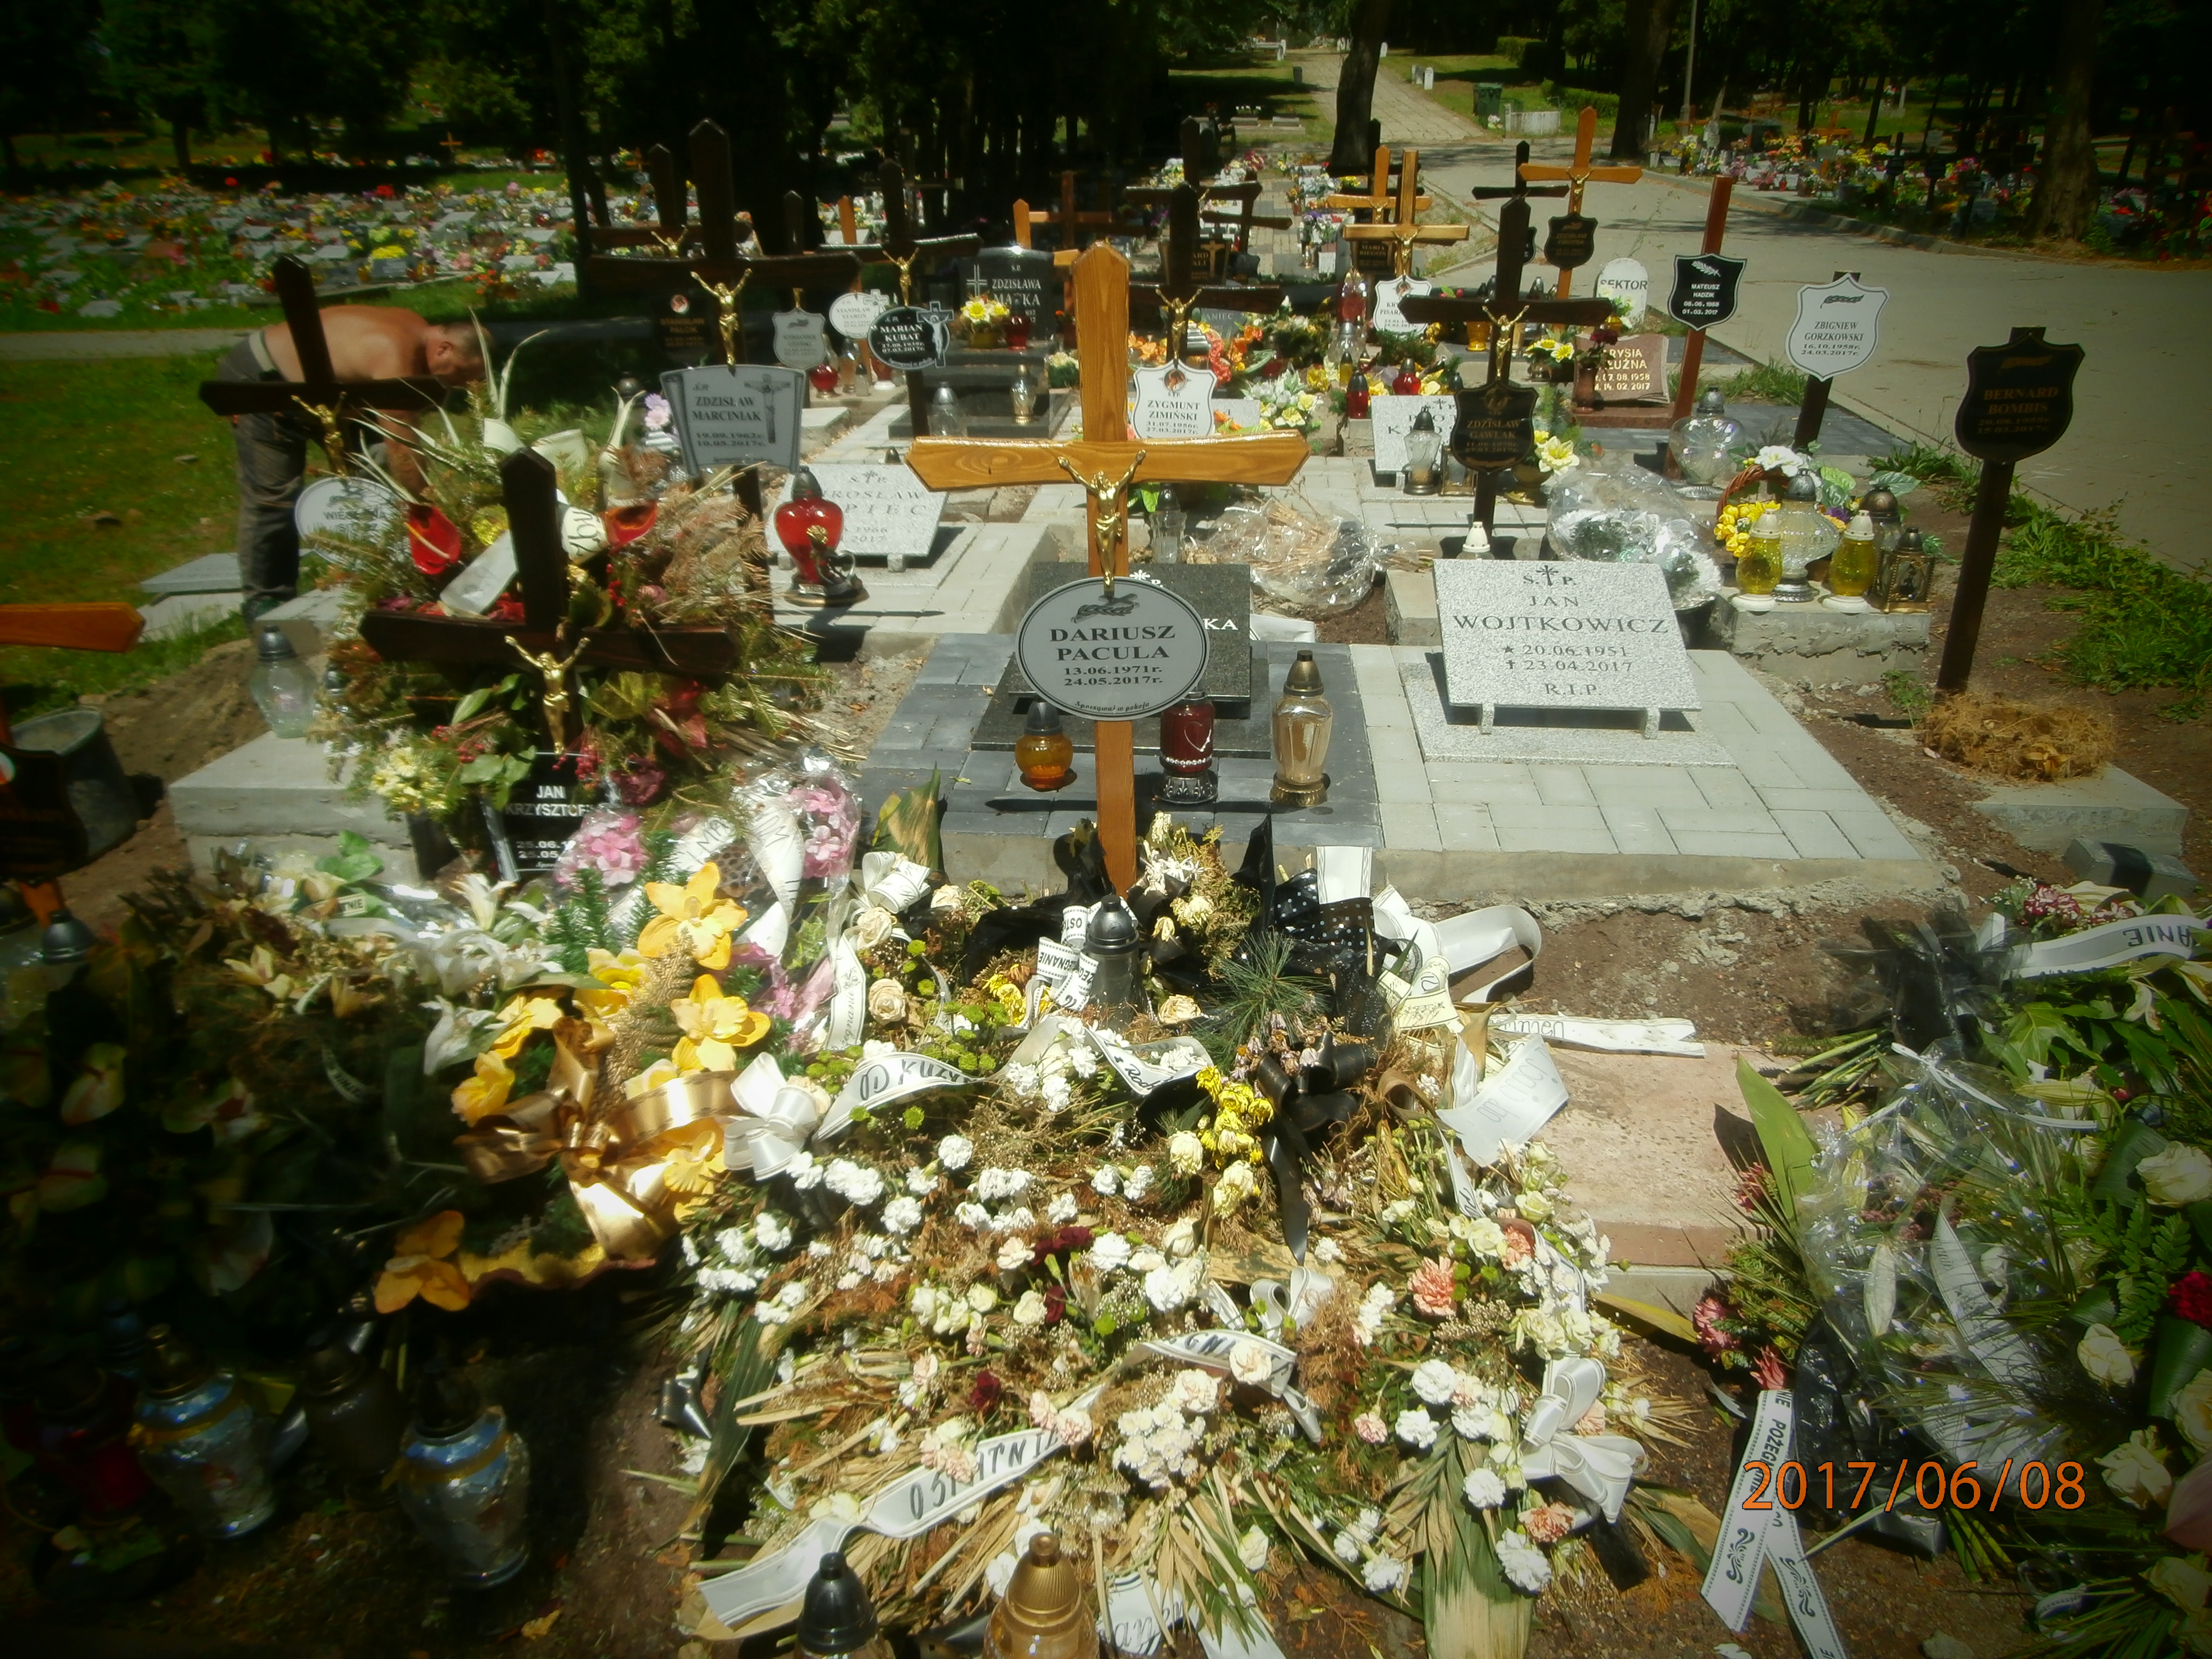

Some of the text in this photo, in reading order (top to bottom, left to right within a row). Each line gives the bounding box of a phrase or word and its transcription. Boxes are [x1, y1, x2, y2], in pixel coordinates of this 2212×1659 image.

[992, 278, 1042, 290] ZDZISŁAWA
[1600, 279, 1648, 290] SEKTOR
[993, 293, 1041, 306] MAKA
[879, 324, 924, 334] MARIAN
[1814, 321, 1858, 330] ZBIGNIEW
[884, 332, 922, 342] KUBAT
[1804, 332, 1864, 341] GORZKOWSKI
[1603, 348, 1642, 358] RYSIA
[1983, 387, 2059, 400] BERNARD
[695, 396, 755, 407] ZDZISŁAW
[1147, 400, 1200, 410] ZYGMUNT
[1987, 402, 2048, 415] BOMBIS
[692, 410, 762, 421] MARCINIAK
[1148, 409, 1198, 421] ZIMIŃSKI
[1467, 420, 1520, 428] ZDZISŁAW
[1469, 431, 1516, 439] GAWLAK
[824, 490, 922, 500] ROSŁAW
[1528, 596, 1578, 607] JAN
[1453, 615, 1669, 633] WOJTKOWICZ
[1049, 625, 1176, 642] DARIUSZ
[1056, 645, 1170, 661] PACULA
[1064, 665, 1163, 675] 13.06.1971r.
[1064, 676, 1163, 686] 24.05.2017r.
[1545, 683, 1602, 696] R.I.P.
[1074, 700, 1116, 712] Spoczywaj
[1125, 701, 1150, 713] pokoju
[536, 785, 566, 799] JAN
[2122, 925, 2193, 949] ANIE
